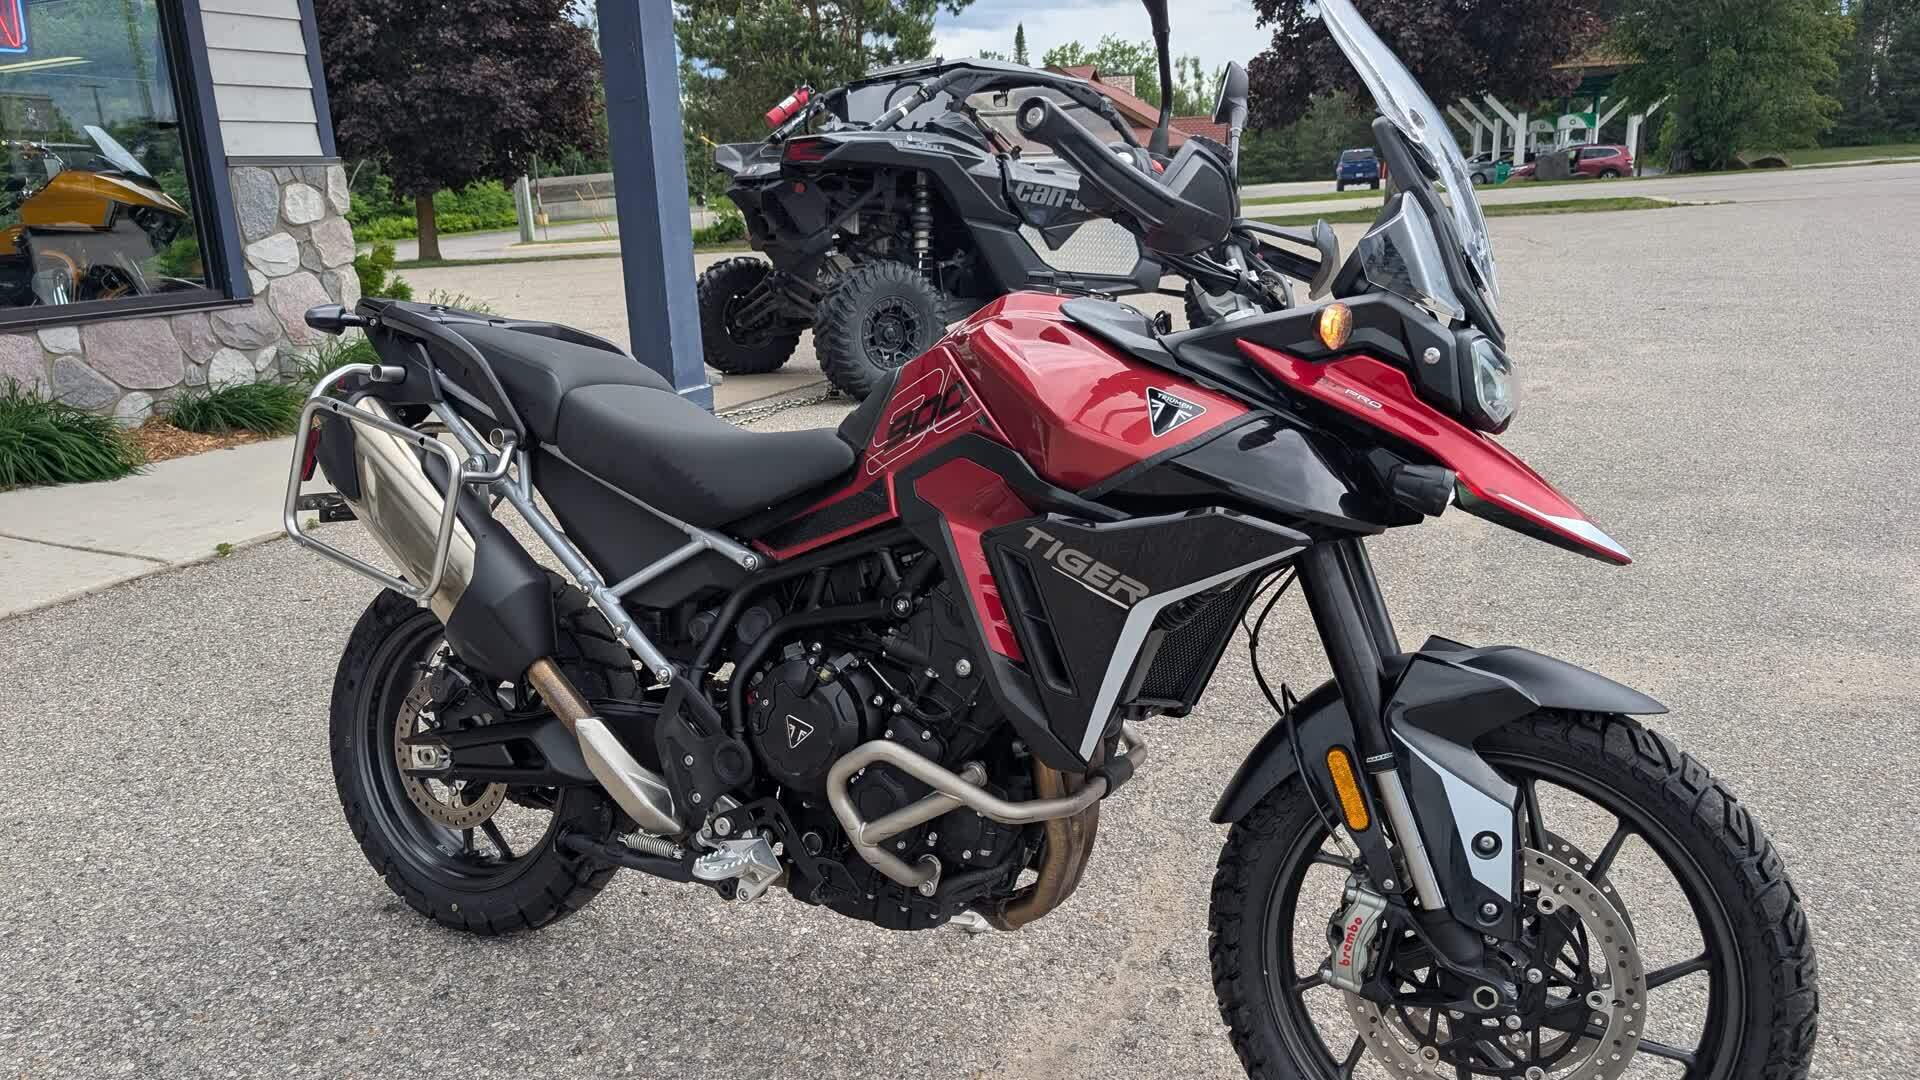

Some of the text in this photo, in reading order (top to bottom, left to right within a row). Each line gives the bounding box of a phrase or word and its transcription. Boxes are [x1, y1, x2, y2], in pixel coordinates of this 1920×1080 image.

[1157, 392, 1193, 410] TRIUMPH
[1344, 388, 1383, 409] PRO
[1023, 526, 1150, 604] TIGER
[1338, 917, 1363, 967] brembo
